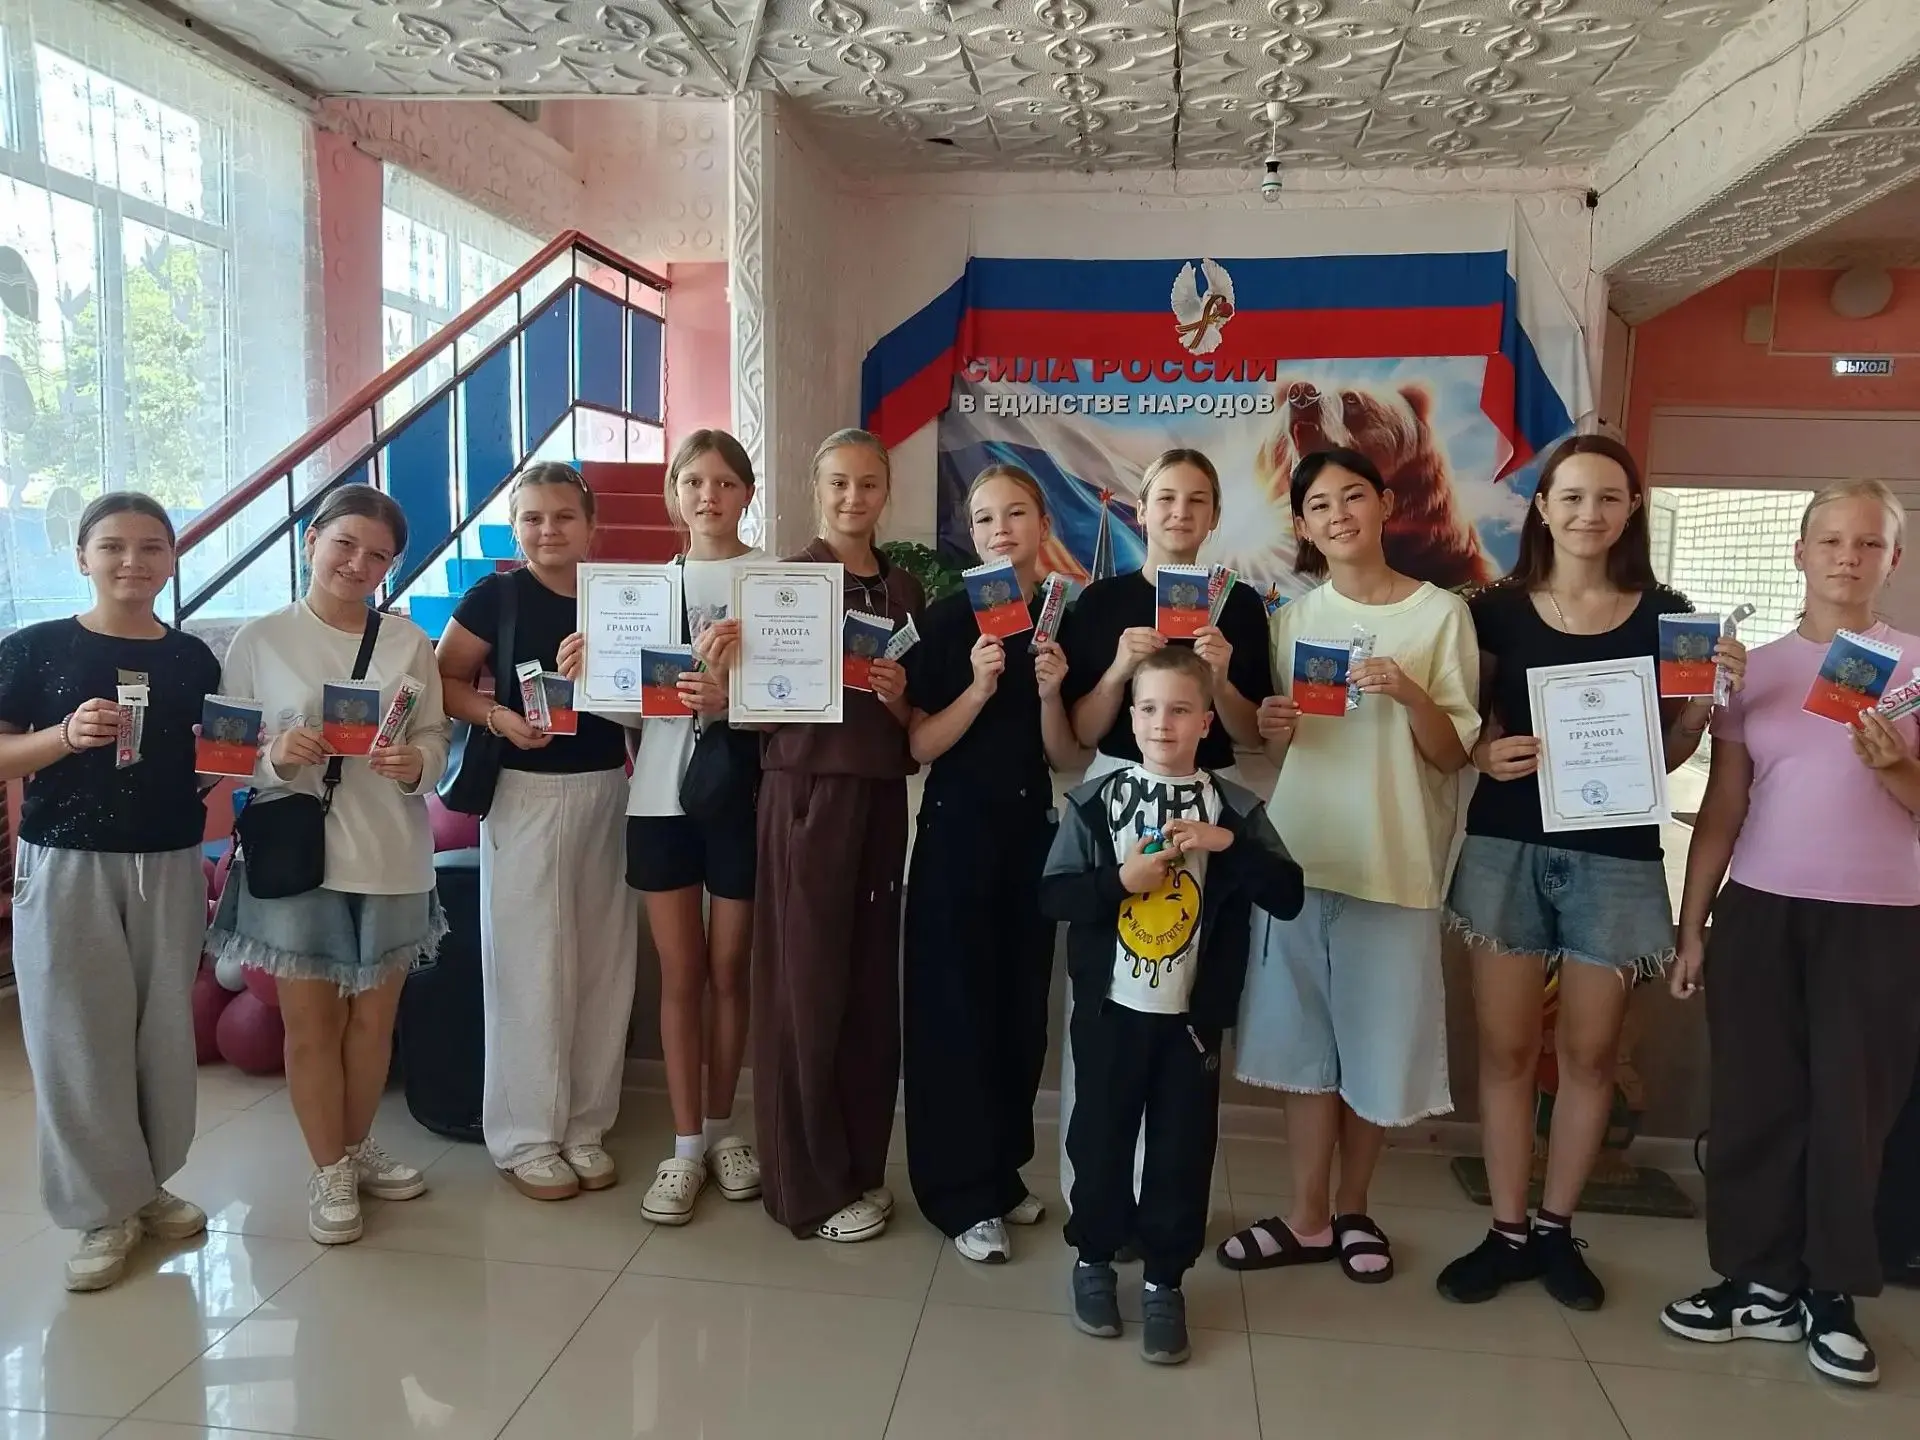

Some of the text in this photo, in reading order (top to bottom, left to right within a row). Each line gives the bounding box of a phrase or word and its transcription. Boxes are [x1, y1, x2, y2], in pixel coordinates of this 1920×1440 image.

[962, 357, 1277, 383] СИЛА РОССИИ
[958, 393, 1275, 417] В ЕДИНСТВЕ НАРОДОВ
[606, 624, 652, 632] ГРАМОТА
[761, 627, 810, 636] ГРАМОТА
[1568, 728, 1624, 740] ГРАМОТА
[1129, 919, 1184, 945] IN GOOD SPIRITS
